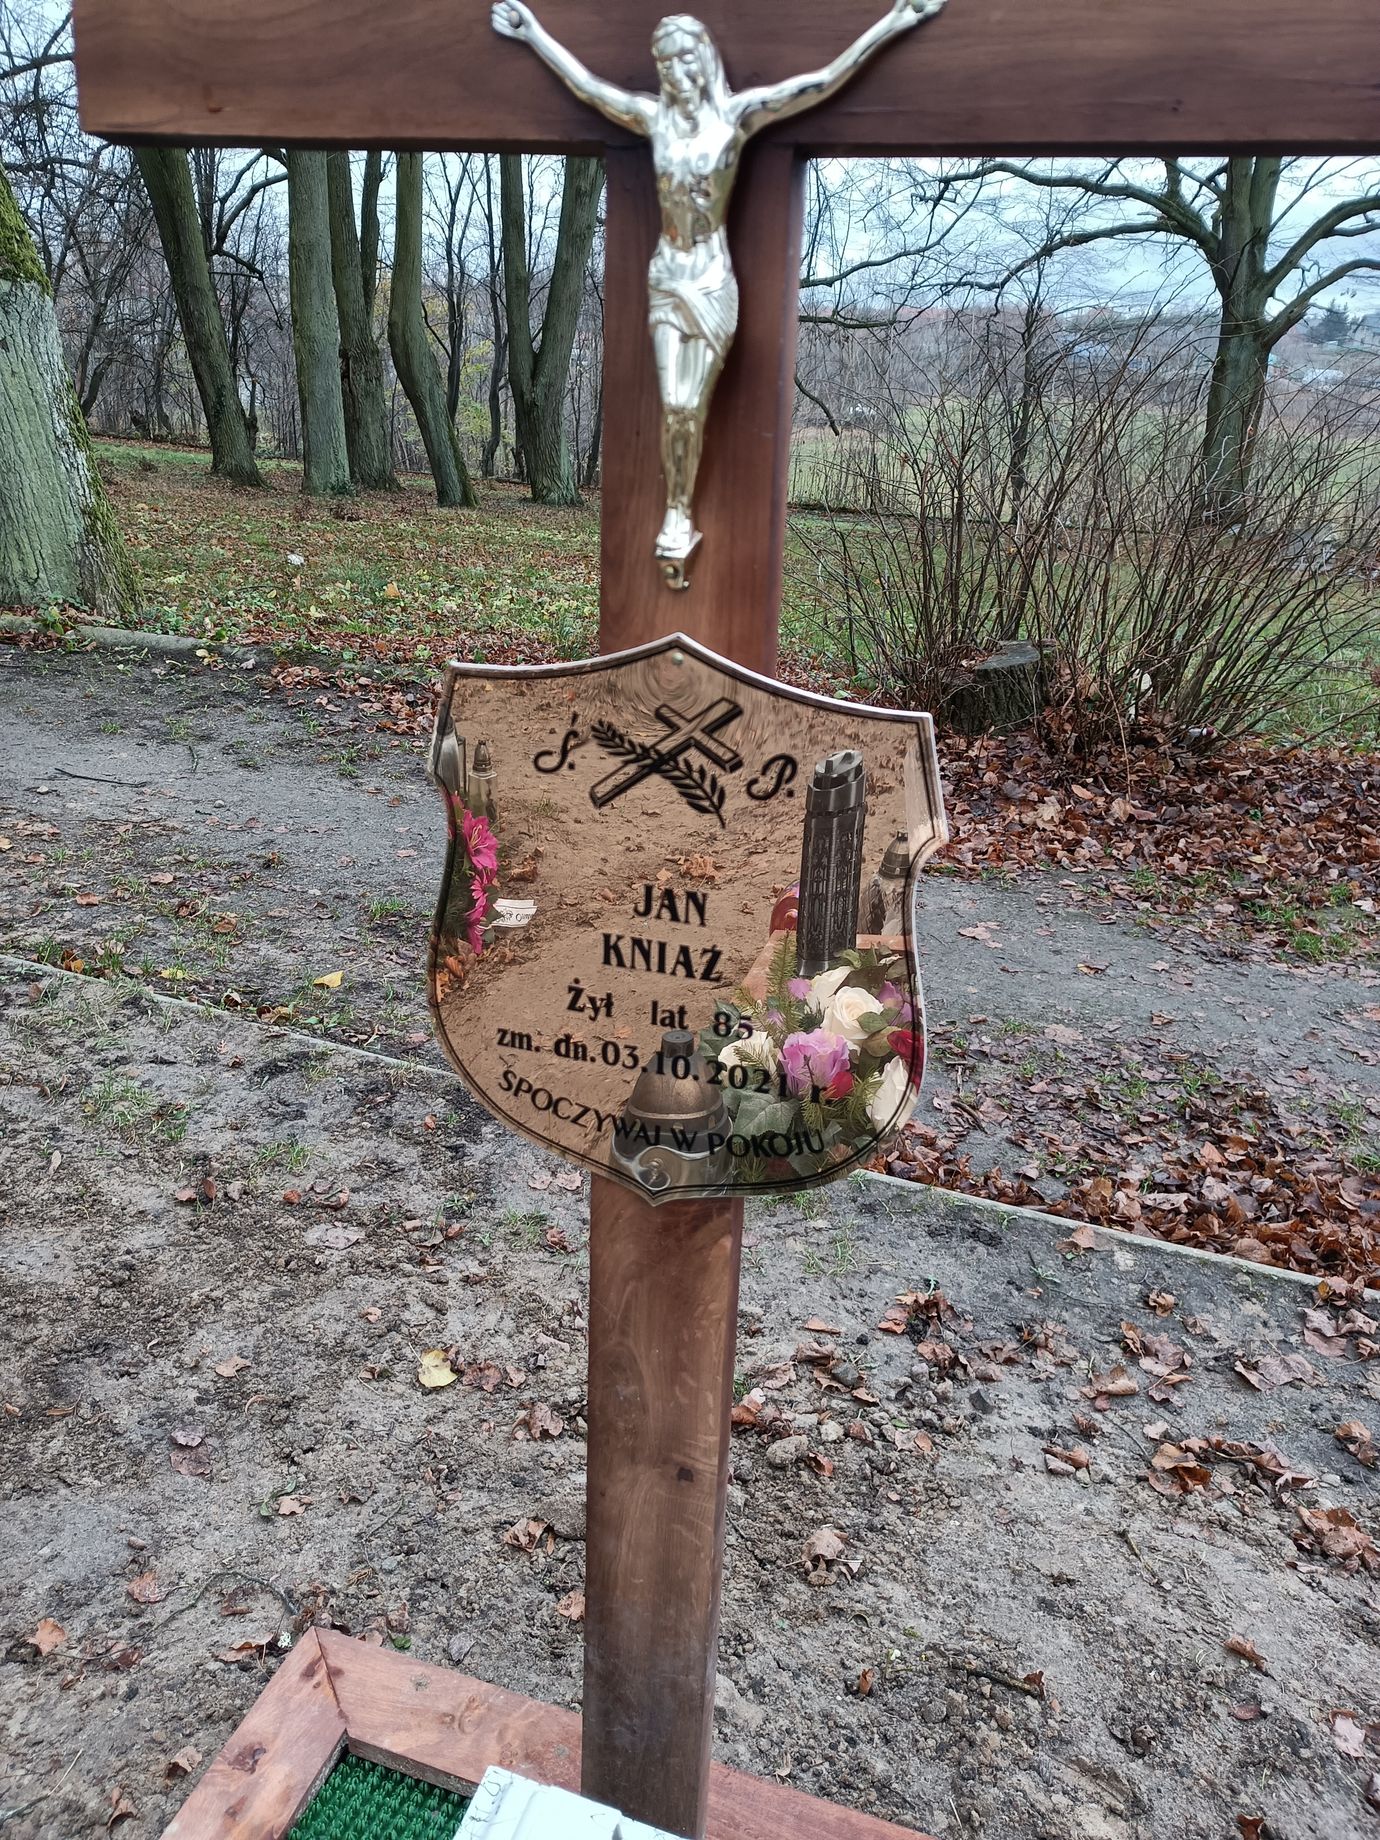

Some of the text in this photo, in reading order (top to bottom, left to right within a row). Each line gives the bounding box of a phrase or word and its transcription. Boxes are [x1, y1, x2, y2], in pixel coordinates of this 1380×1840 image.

[745, 753, 799, 800] P.
[633, 884, 708, 928] JAN
[601, 932, 723, 983] KNIAŹ
[566, 977, 754, 1040] Żył lat 85
[497, 1028, 541, 1053] zm.
[498, 1069, 826, 1158] SPOCZYWAJ W POKOJU
